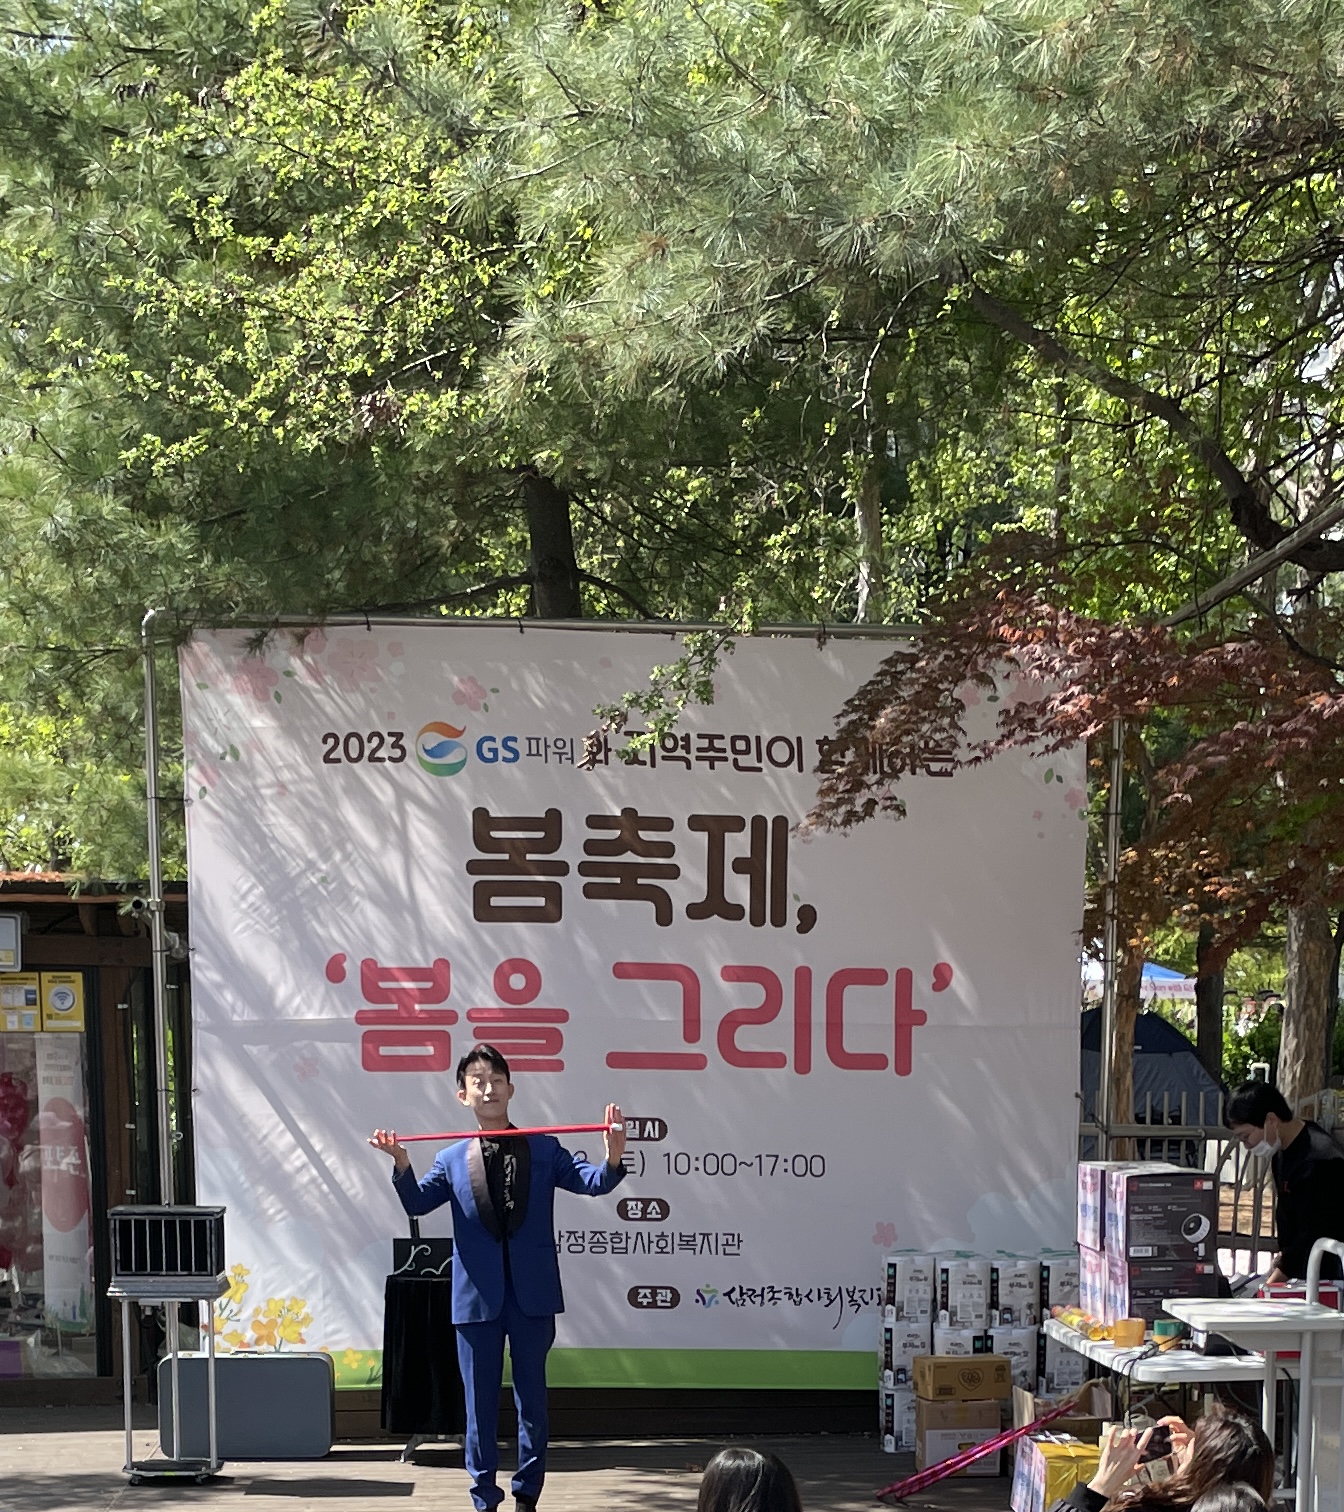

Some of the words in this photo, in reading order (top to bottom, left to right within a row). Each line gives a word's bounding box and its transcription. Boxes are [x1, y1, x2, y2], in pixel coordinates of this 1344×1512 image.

[322, 731, 407, 764] 2023
[476, 735, 520, 764] GS
[525, 736, 575, 765] 파워
[622, 729, 806, 774] 지역주민이
[465, 807, 818, 933] 봄축제,
[662, 1152, 826, 1178] 10:00~17:00
